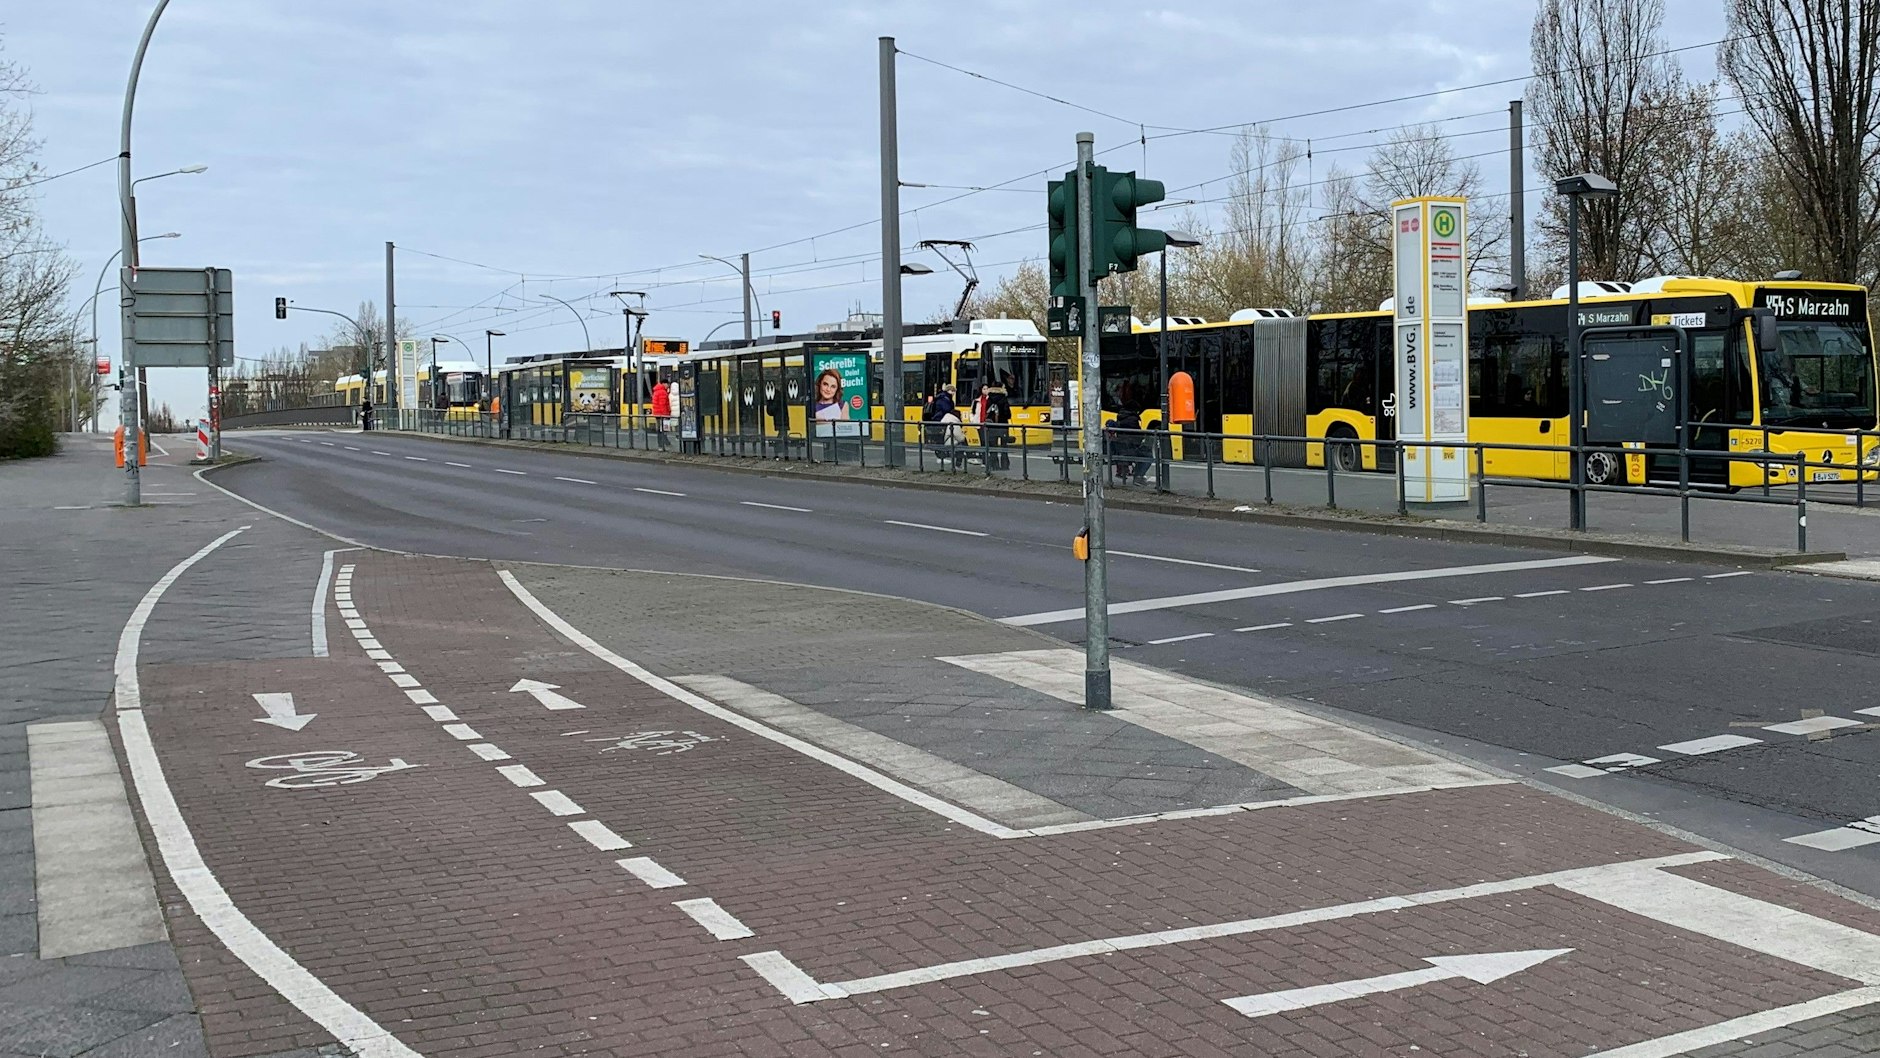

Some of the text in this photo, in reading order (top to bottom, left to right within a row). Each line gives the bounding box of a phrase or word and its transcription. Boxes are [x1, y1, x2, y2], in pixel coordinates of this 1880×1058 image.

[1108, 262, 1119, 271] F7
[1786, 297, 1795, 315] S
[1798, 298, 1850, 316] Marzahn
[1588, 313, 1595, 324] S
[1596, 312, 1629, 324] Marzahn
[1674, 315, 1703, 327] Tickets
[818, 357, 856, 371] Schreib!
[845, 369, 860, 377] Dein!
[841, 376, 864, 388] Buch!
